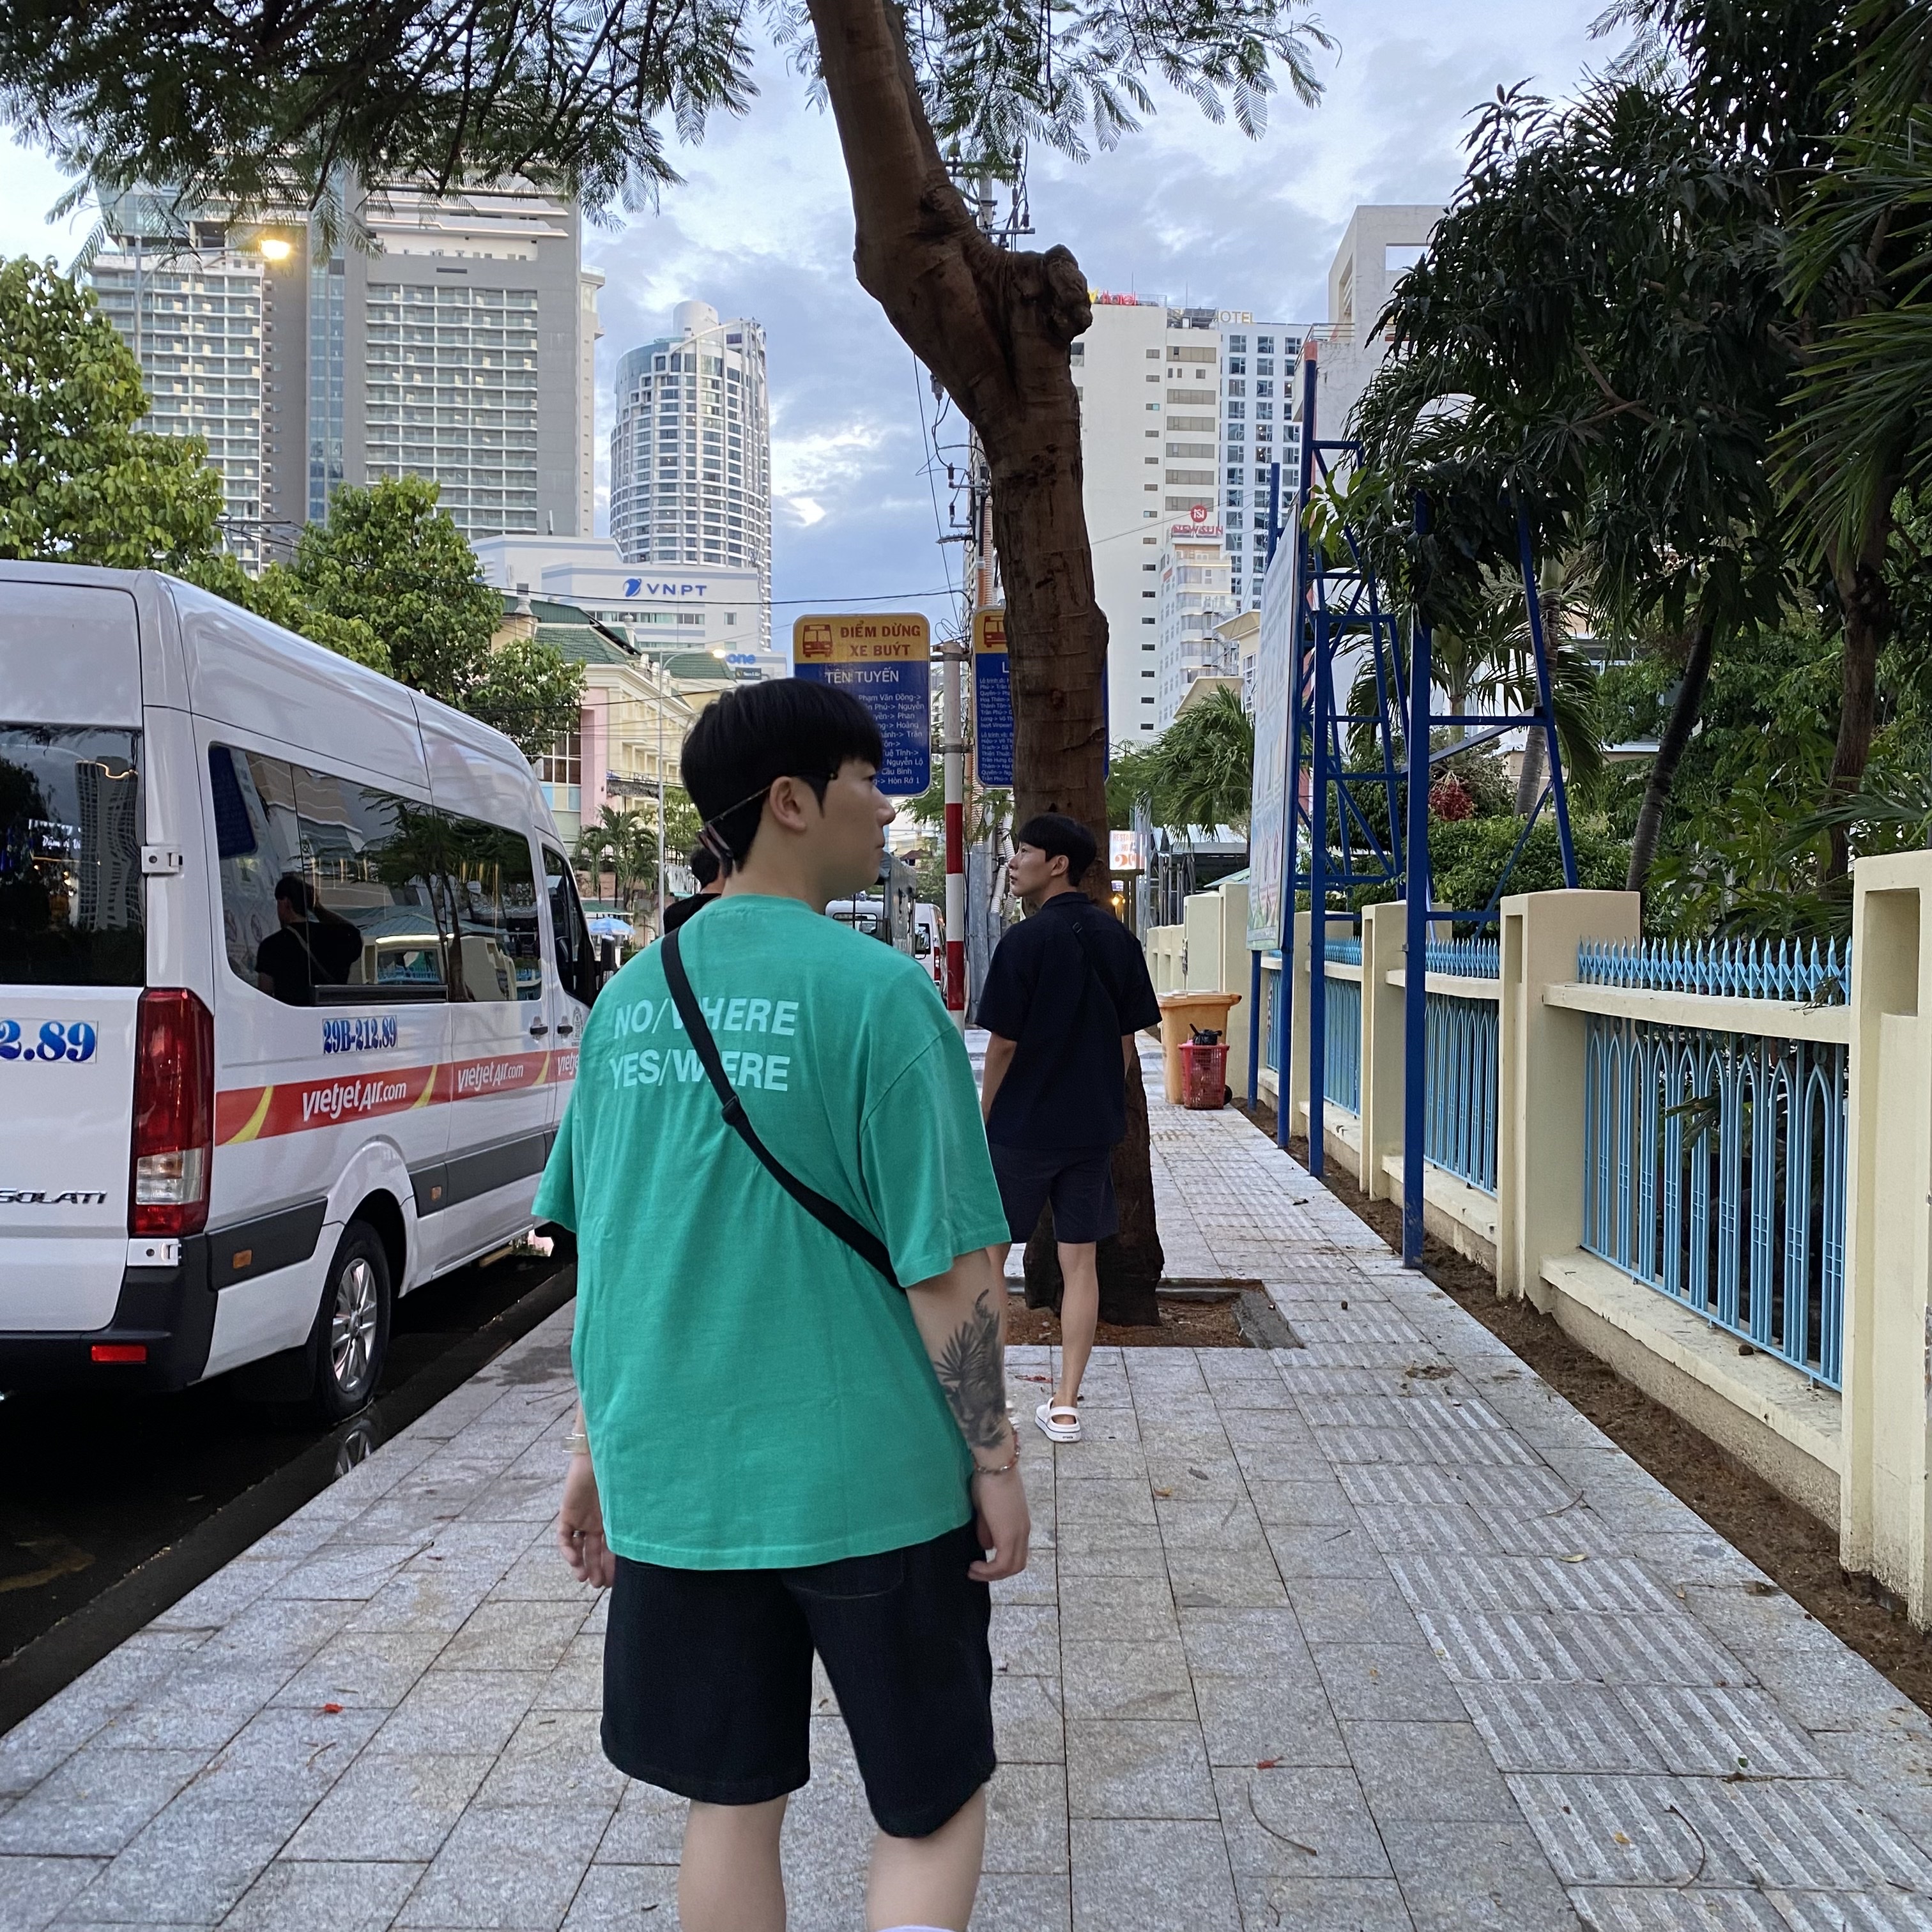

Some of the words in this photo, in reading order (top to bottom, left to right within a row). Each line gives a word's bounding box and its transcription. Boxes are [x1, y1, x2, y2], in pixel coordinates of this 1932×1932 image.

[1172, 525, 1199, 535] NEW
[1199, 525, 1223, 535] SUN
[646, 583, 707, 596] VNPT
[840, 621, 877, 638] ĐIỂM
[882, 622, 921, 637] DỪNG
[850, 645, 868, 657] XE
[873, 641, 910, 656] BUÝT
[825, 668, 850, 684] TÊN
[855, 666, 899, 683] TUYẾN
[898, 701, 924, 710] Nguyễn
[873, 712, 895, 721] yền->
[886, 756, 913, 767] Nguyễn
[915, 757, 923, 766] Lộ
[882, 767, 894, 775] Cầu
[0, 1019, 95, 1062] 2.89
[323, 1016, 397, 1054] 29B-212.89
[609, 1048, 790, 1092] YES/WERE
[0, 1188, 107, 1204] SOLATI
